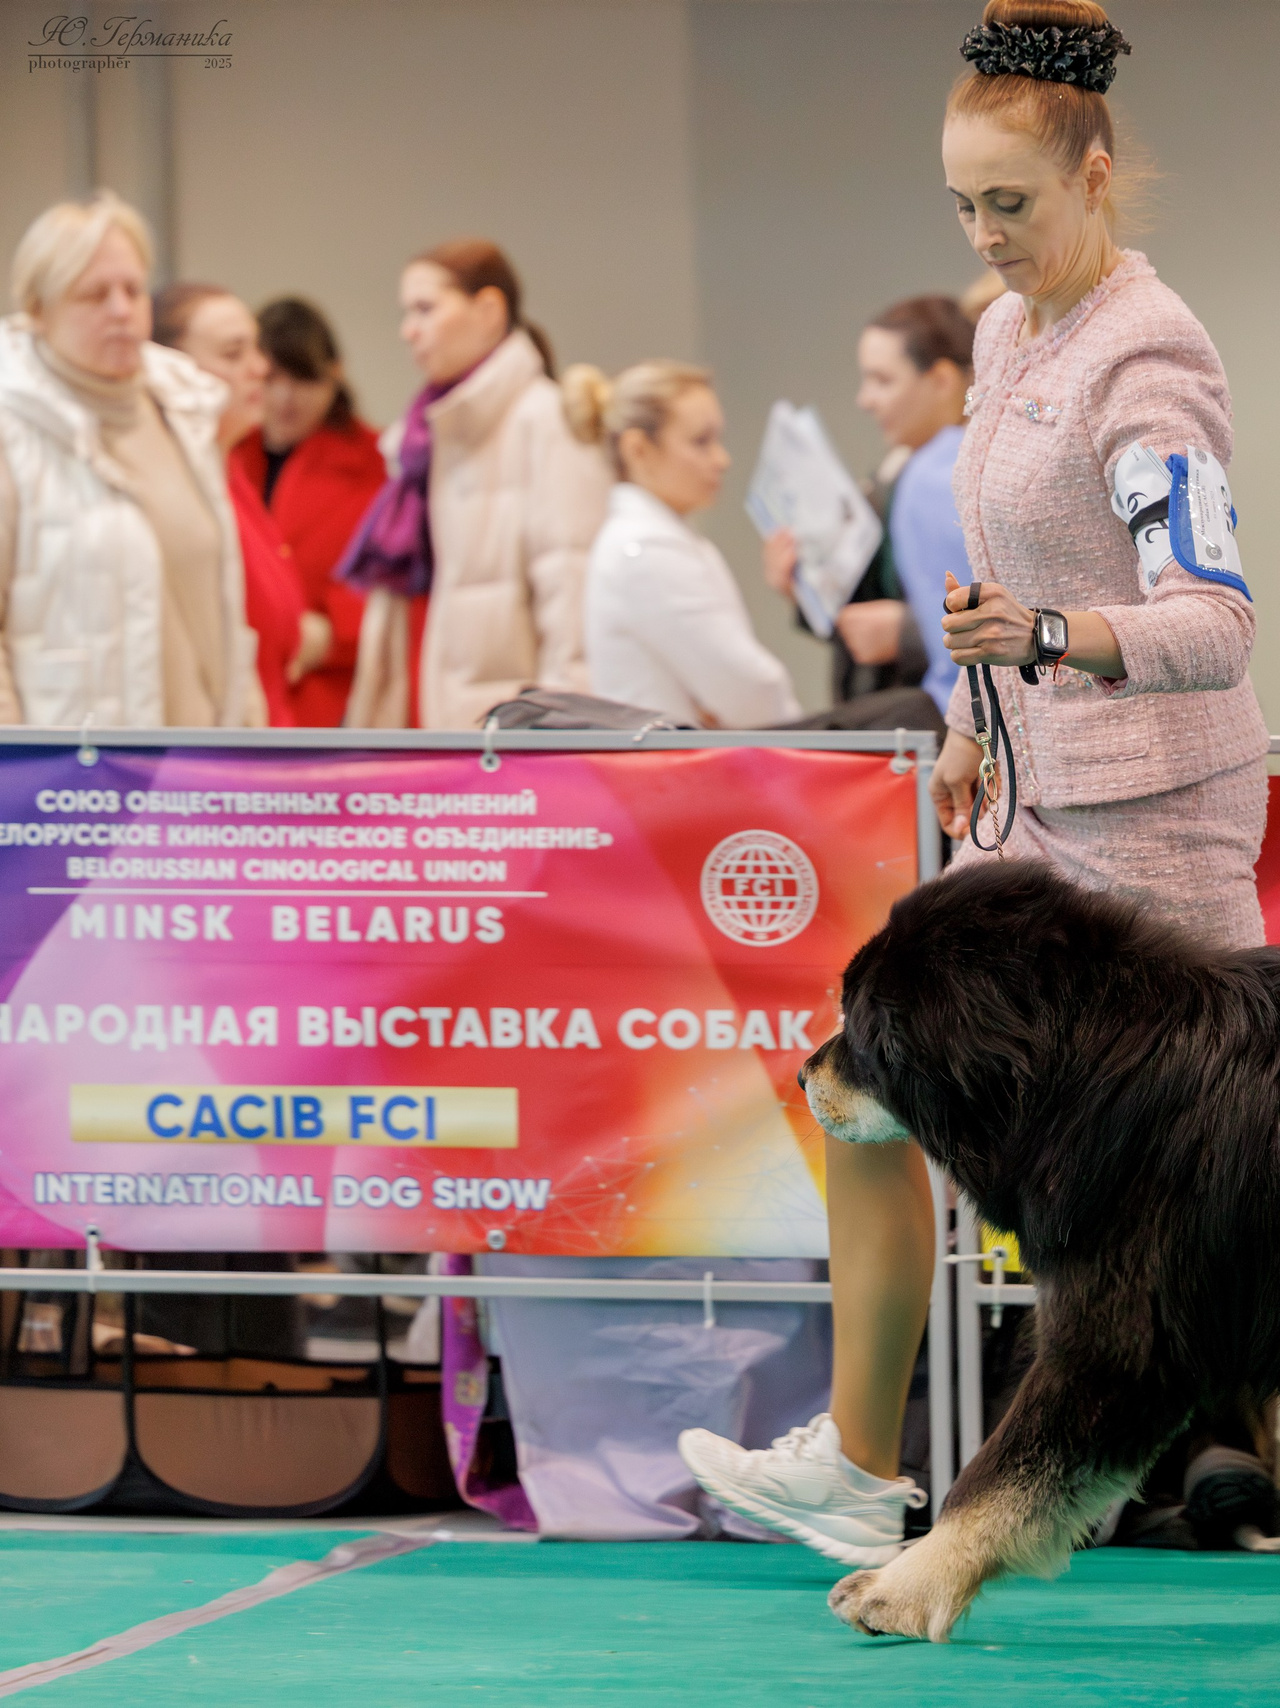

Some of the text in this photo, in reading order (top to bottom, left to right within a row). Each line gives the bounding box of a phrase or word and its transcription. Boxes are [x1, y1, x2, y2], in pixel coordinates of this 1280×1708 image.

[36, 789, 537, 818] СОЮЗ ОБЩЕСТВЕННЫХ ОБЪЕДИНЕНИЙ
[167, 826, 406, 849] КИНОЛОГИЧЕСКОЕ
[66, 857, 507, 883] BELORUSSIAN CINOLOGICAL UNION
[734, 879, 784, 897] FCI
[70, 904, 505, 943] MINSK BELARUS
[298, 1006, 602, 1049] ВЫСТАВКА
[617, 1008, 814, 1051] СОБАК
[146, 1092, 438, 1141] CACIB FCI
[34, 1171, 551, 1211] INTERNATIONAL DOG SHOW
